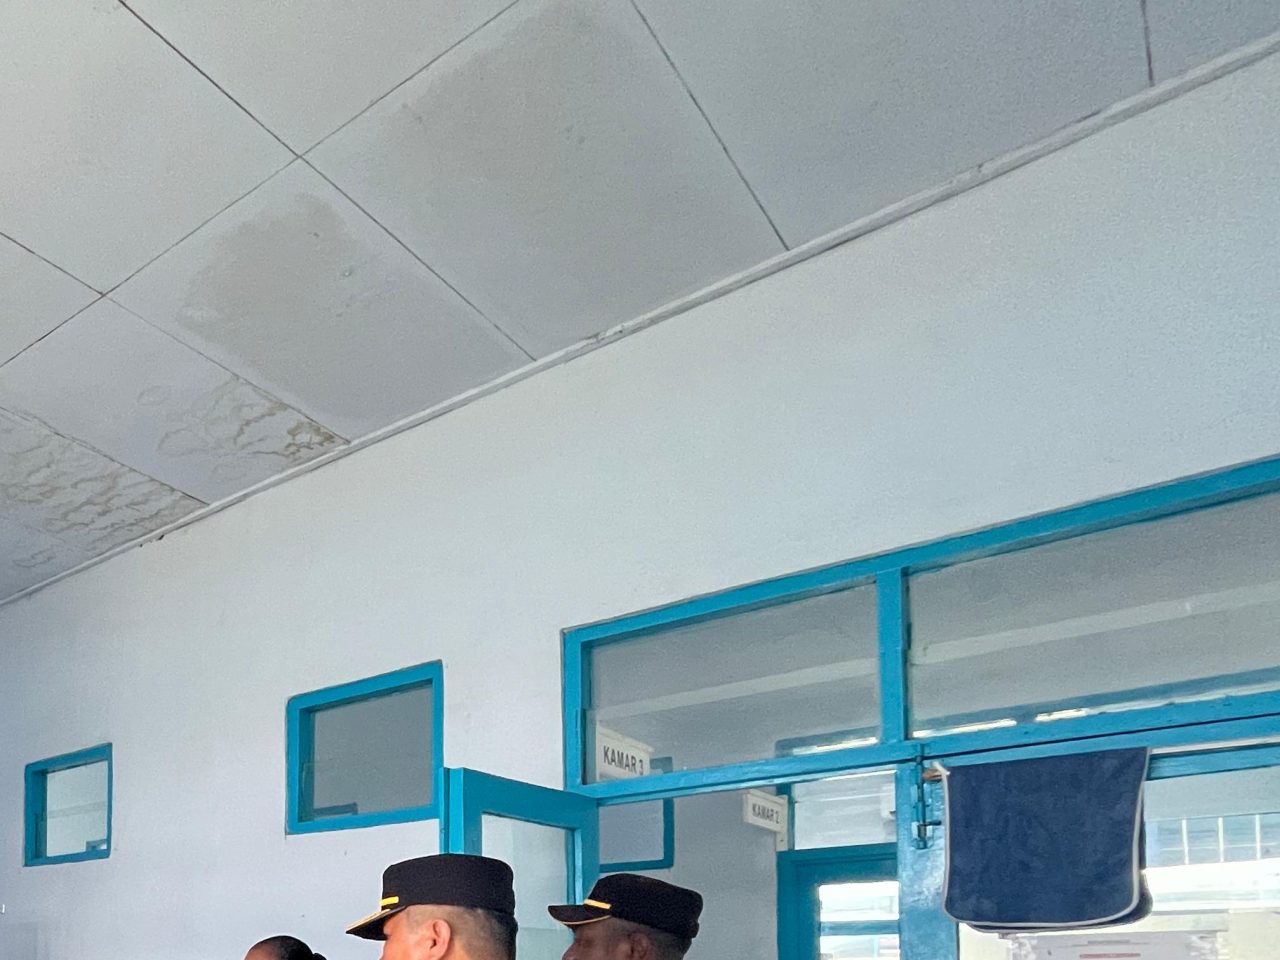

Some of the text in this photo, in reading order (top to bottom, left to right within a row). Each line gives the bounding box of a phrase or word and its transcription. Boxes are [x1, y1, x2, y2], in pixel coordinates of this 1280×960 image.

[602, 745, 645, 776] KAMAR 3
[751, 803, 780, 824] KAMAR 2
